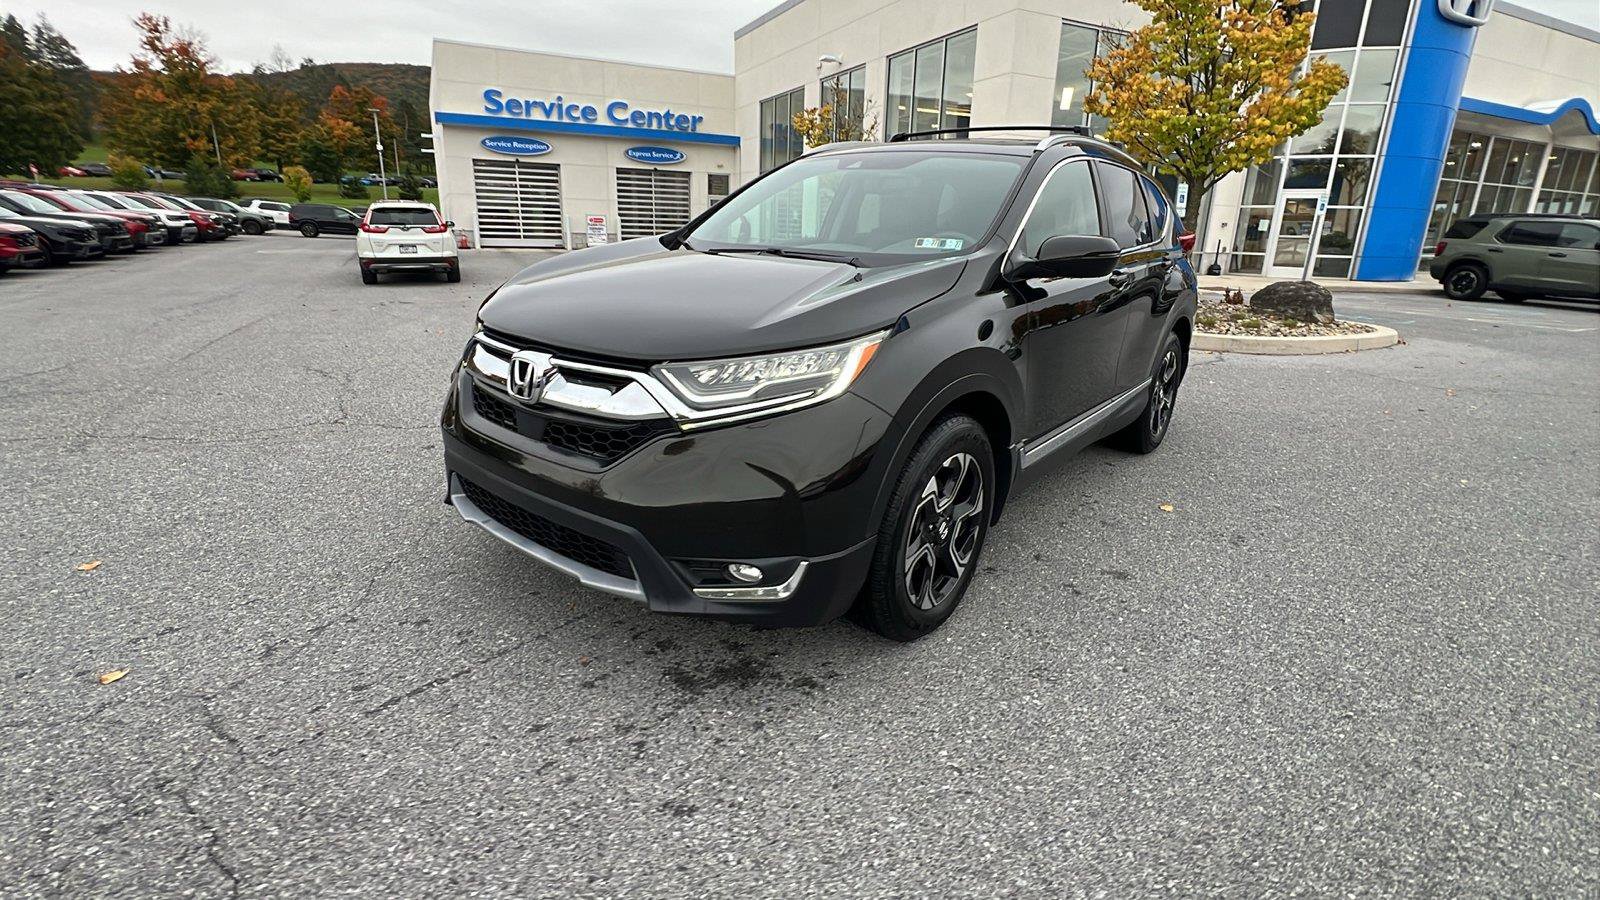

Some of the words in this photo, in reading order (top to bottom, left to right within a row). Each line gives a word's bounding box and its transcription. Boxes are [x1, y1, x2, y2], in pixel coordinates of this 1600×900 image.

[483, 88, 598, 123] Service
[606, 101, 704, 132] Center
[485, 139, 511, 148] Service
[512, 141, 548, 151] Reception
[652, 151, 674, 159] Service
